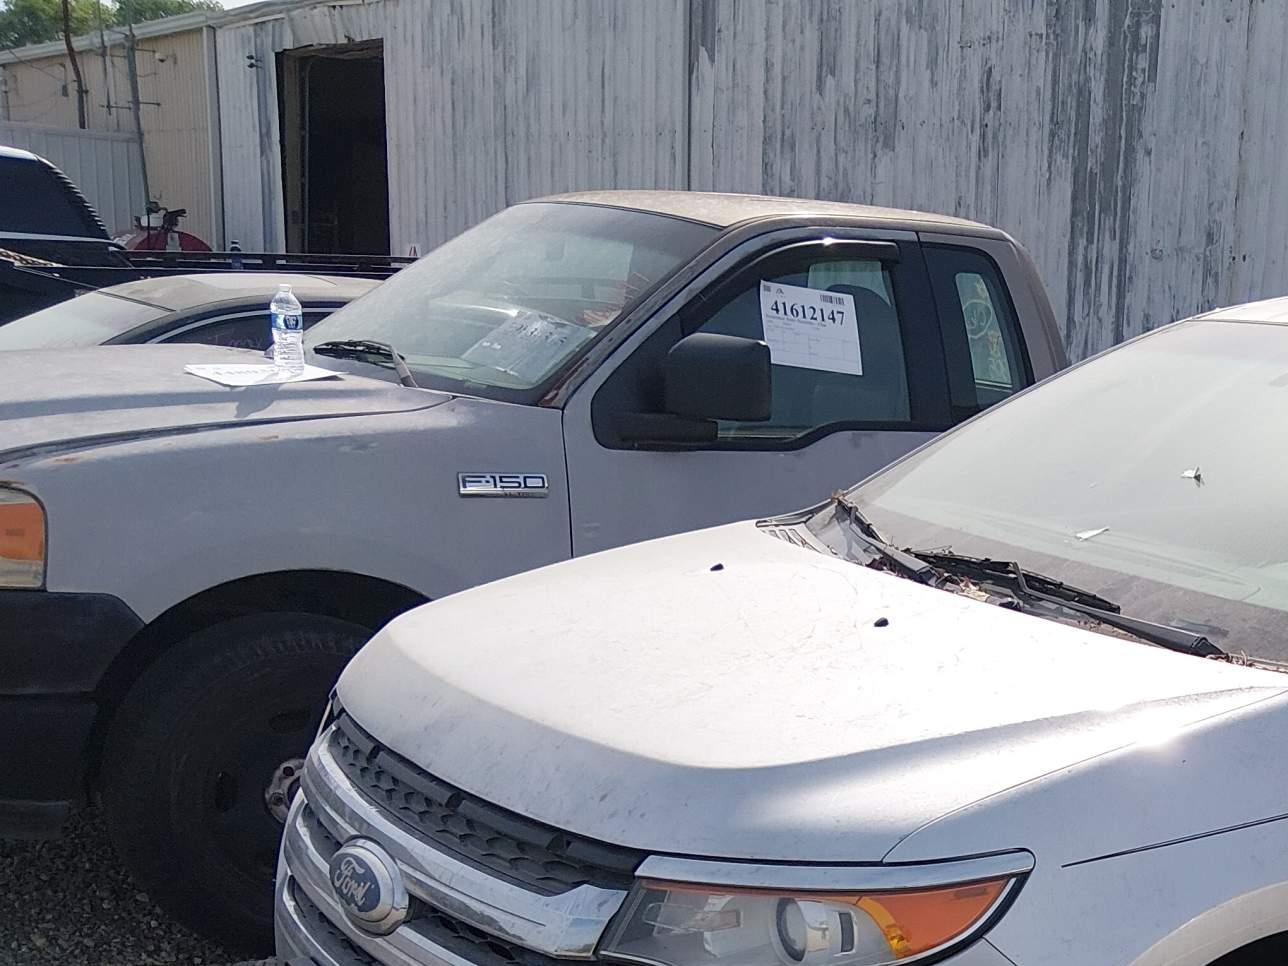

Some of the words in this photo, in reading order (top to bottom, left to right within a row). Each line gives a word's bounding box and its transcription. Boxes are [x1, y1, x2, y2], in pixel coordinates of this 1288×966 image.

[770, 300, 845, 326] 41612147
[462, 475, 546, 489] F-150
[334, 857, 371, 906] Ford
